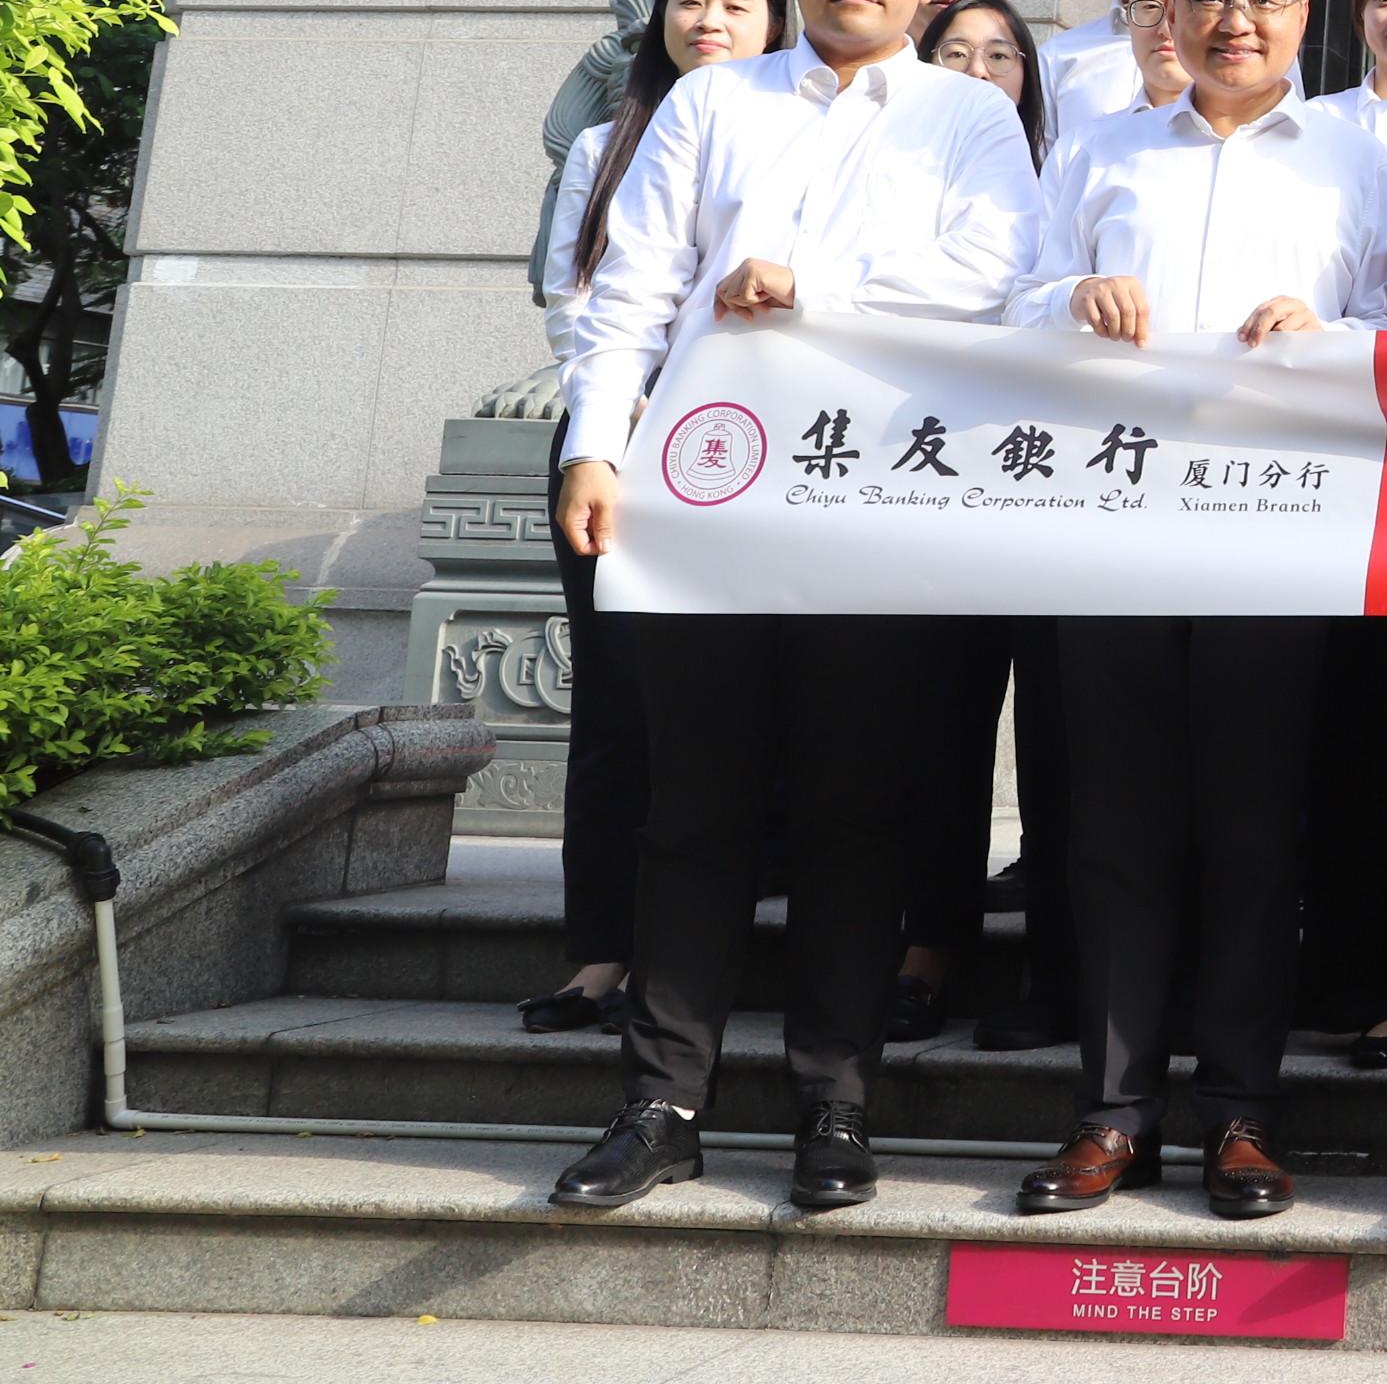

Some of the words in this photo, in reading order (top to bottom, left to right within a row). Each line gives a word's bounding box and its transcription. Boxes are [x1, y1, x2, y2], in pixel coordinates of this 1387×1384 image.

[672, 413, 705, 449] BANKING
[706, 409, 759, 444] CORPORATION
[742, 444, 760, 480] LIMITED
[792, 408, 1159, 485] 集友銀行
[1180, 458, 1330, 490] 厦门分行
[681, 483, 705, 500] HONG
[707, 485, 735, 499] KONG
[785, 484, 846, 506] Chiyu
[859, 485, 951, 510] Banking
[961, 487, 1086, 511] Corporation
[1097, 489, 1148, 512] Ltd.
[1179, 497, 1249, 512] Xiamen
[1256, 498, 1322, 513] Branch
[1071, 1257, 1223, 1300] 注意台阶
[1073, 1303, 1118, 1318] MIND
[1127, 1305, 1161, 1320] THE
[1171, 1307, 1218, 1322] STEP
